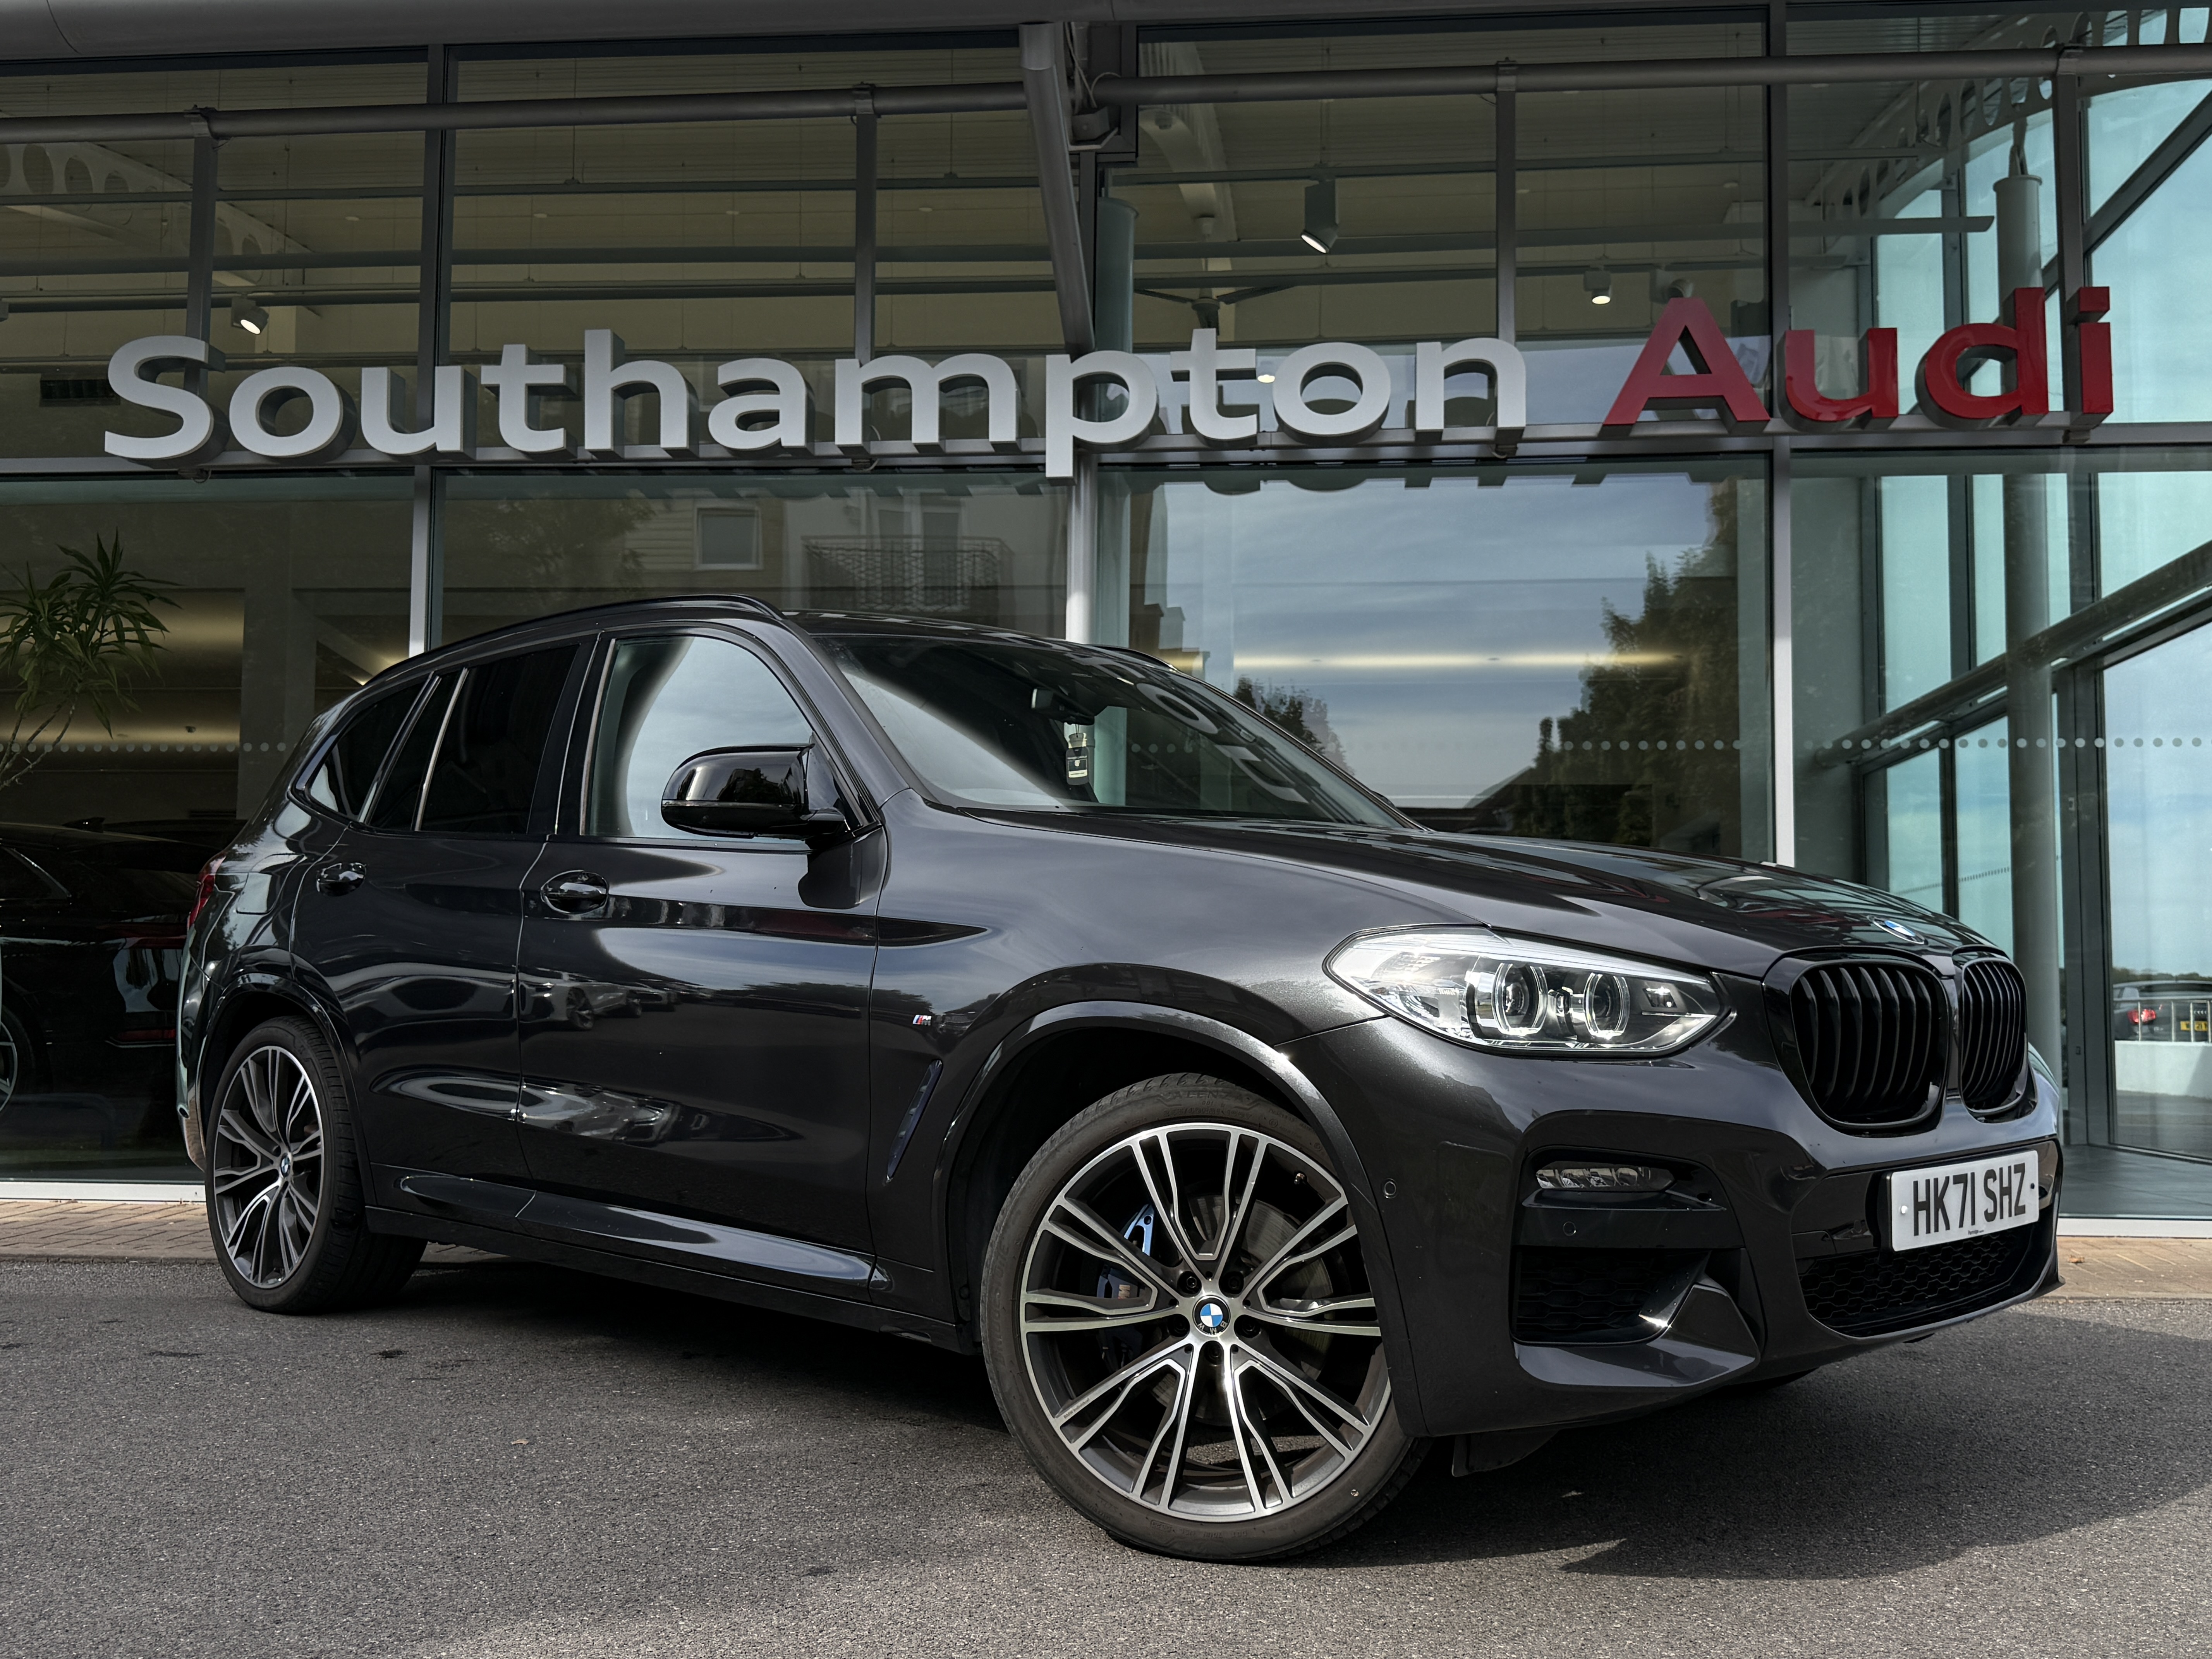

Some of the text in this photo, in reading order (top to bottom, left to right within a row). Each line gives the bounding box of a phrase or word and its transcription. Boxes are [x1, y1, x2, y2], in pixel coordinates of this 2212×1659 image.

[105, 287, 2114, 477] Southampton Audi
[1913, 1163, 2026, 1236] HK71 SHZ
[1198, 1321, 1227, 1336] BMW
